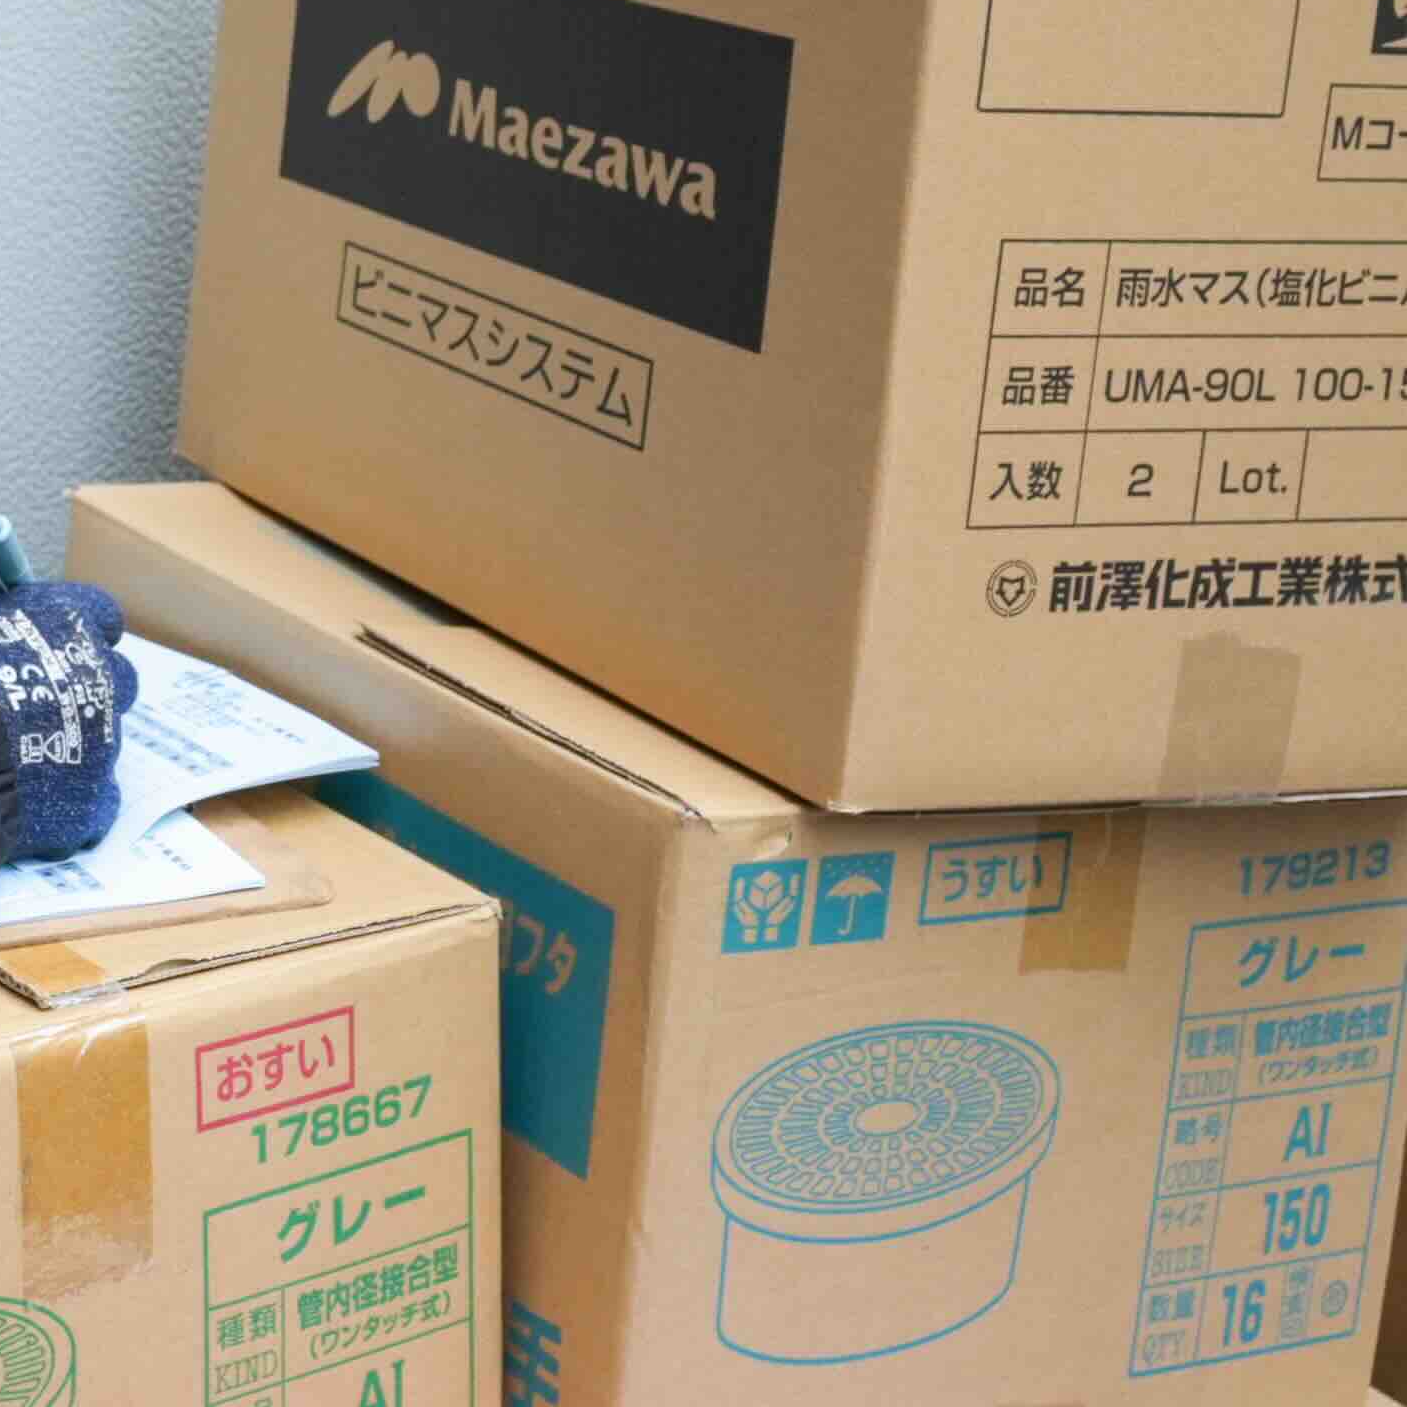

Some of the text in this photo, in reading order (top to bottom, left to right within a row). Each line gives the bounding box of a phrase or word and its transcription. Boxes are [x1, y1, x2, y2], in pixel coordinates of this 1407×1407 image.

[448, 78, 717, 221] Maezawa
[1013, 267, 1087, 309] 品名
[351, 263, 634, 427] ビニマスシステム
[1000, 365, 1076, 407] 品番
[1103, 368, 1277, 404] UMA-90L
[988, 460, 1064, 501] 入数
[1126, 463, 1155, 498] 2
[1218, 460, 1288, 495] Lot.
[940, 854, 1044, 903] うすい
[1239, 839, 1393, 899] 179213
[1238, 936, 1367, 989] グレー
[215, 1034, 336, 1103] おすい
[250, 1074, 433, 1164] 178667
[1282, 1101, 1333, 1163] AI
[276, 1185, 427, 1263] グレー
[1263, 1182, 1332, 1256] 150
[296, 1241, 459, 1331] 管内径接合型
[1221, 1278, 1266, 1348] 16
[216, 1302, 278, 1352] 種類
[308, 1290, 452, 1360] (ワンタッチ式)
[214, 1349, 279, 1396] KIND
